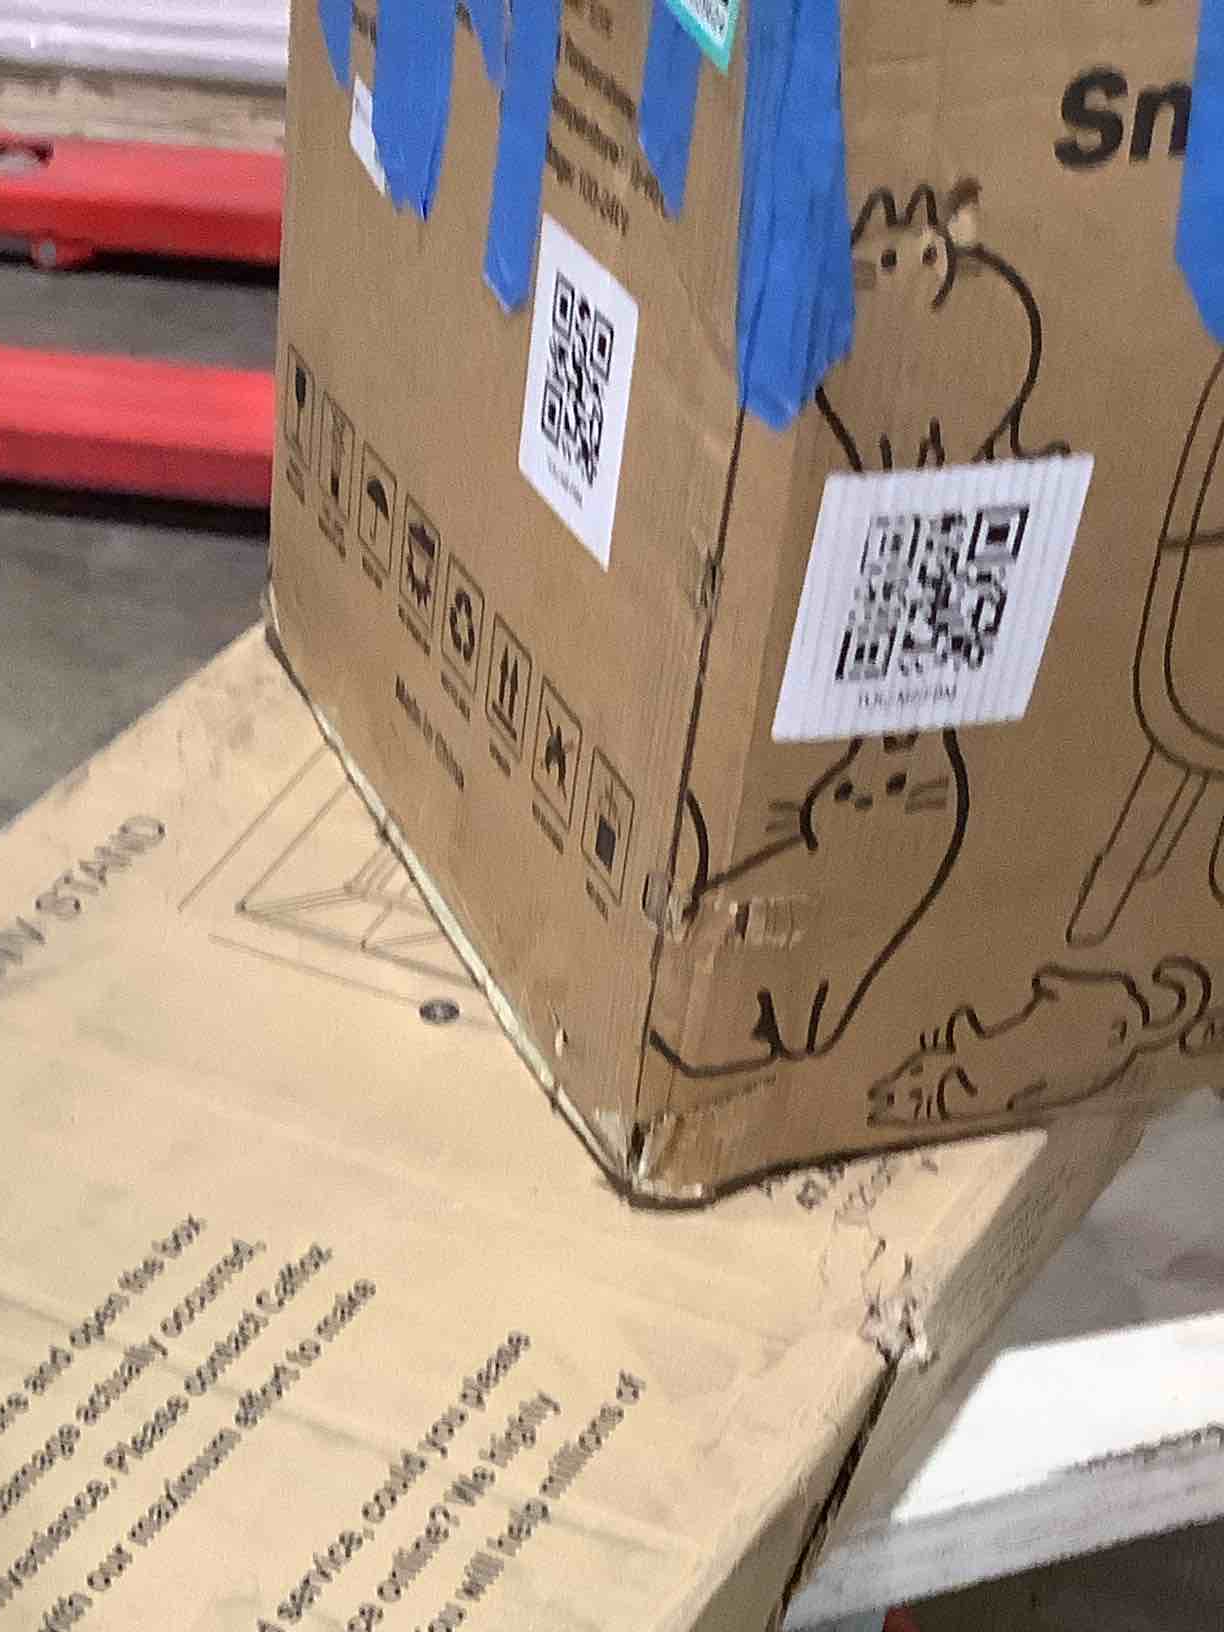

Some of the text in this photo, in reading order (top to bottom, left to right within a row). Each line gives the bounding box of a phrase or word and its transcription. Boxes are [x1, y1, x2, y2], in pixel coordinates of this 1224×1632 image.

[23, 1345, 74, 1396] and
[68, 1293, 130, 1350] open
[118, 1257, 165, 1294] the
[86, 1542, 133, 1593] our
[285, 1340, 322, 1367] to
[315, 1279, 377, 1342] make
[103, 1396, 190, 1475] Please
[361, 1450, 428, 1524] could
[418, 1406, 468, 1459] you
[459, 1332, 531, 1411] please
[443, 1467, 496, 1507] We
[455, 1551, 505, 1602] will
[486, 1500, 552, 1557] help
